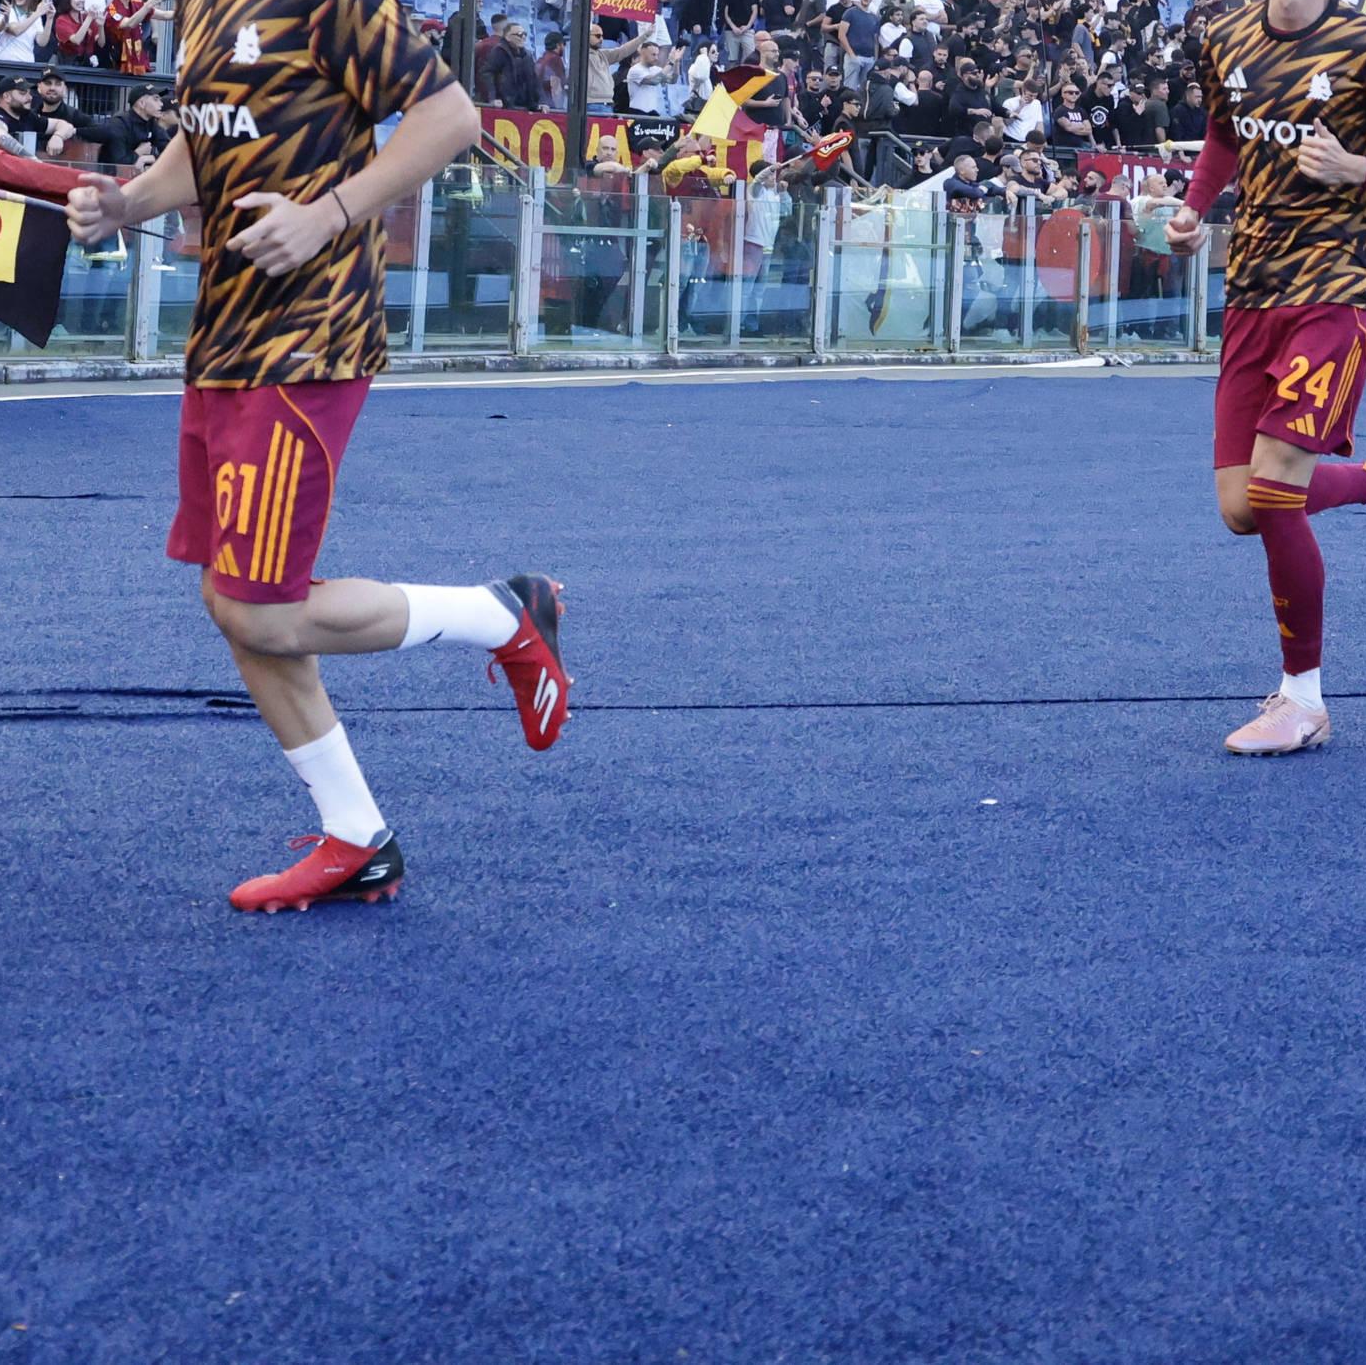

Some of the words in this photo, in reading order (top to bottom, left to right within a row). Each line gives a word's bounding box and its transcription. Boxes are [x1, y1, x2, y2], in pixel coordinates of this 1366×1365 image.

[178, 102, 261, 140] OYOTA
[1232, 115, 1315, 146] TOYOT
[1277, 355, 1337, 408] 24
[215, 461, 258, 535] 61
